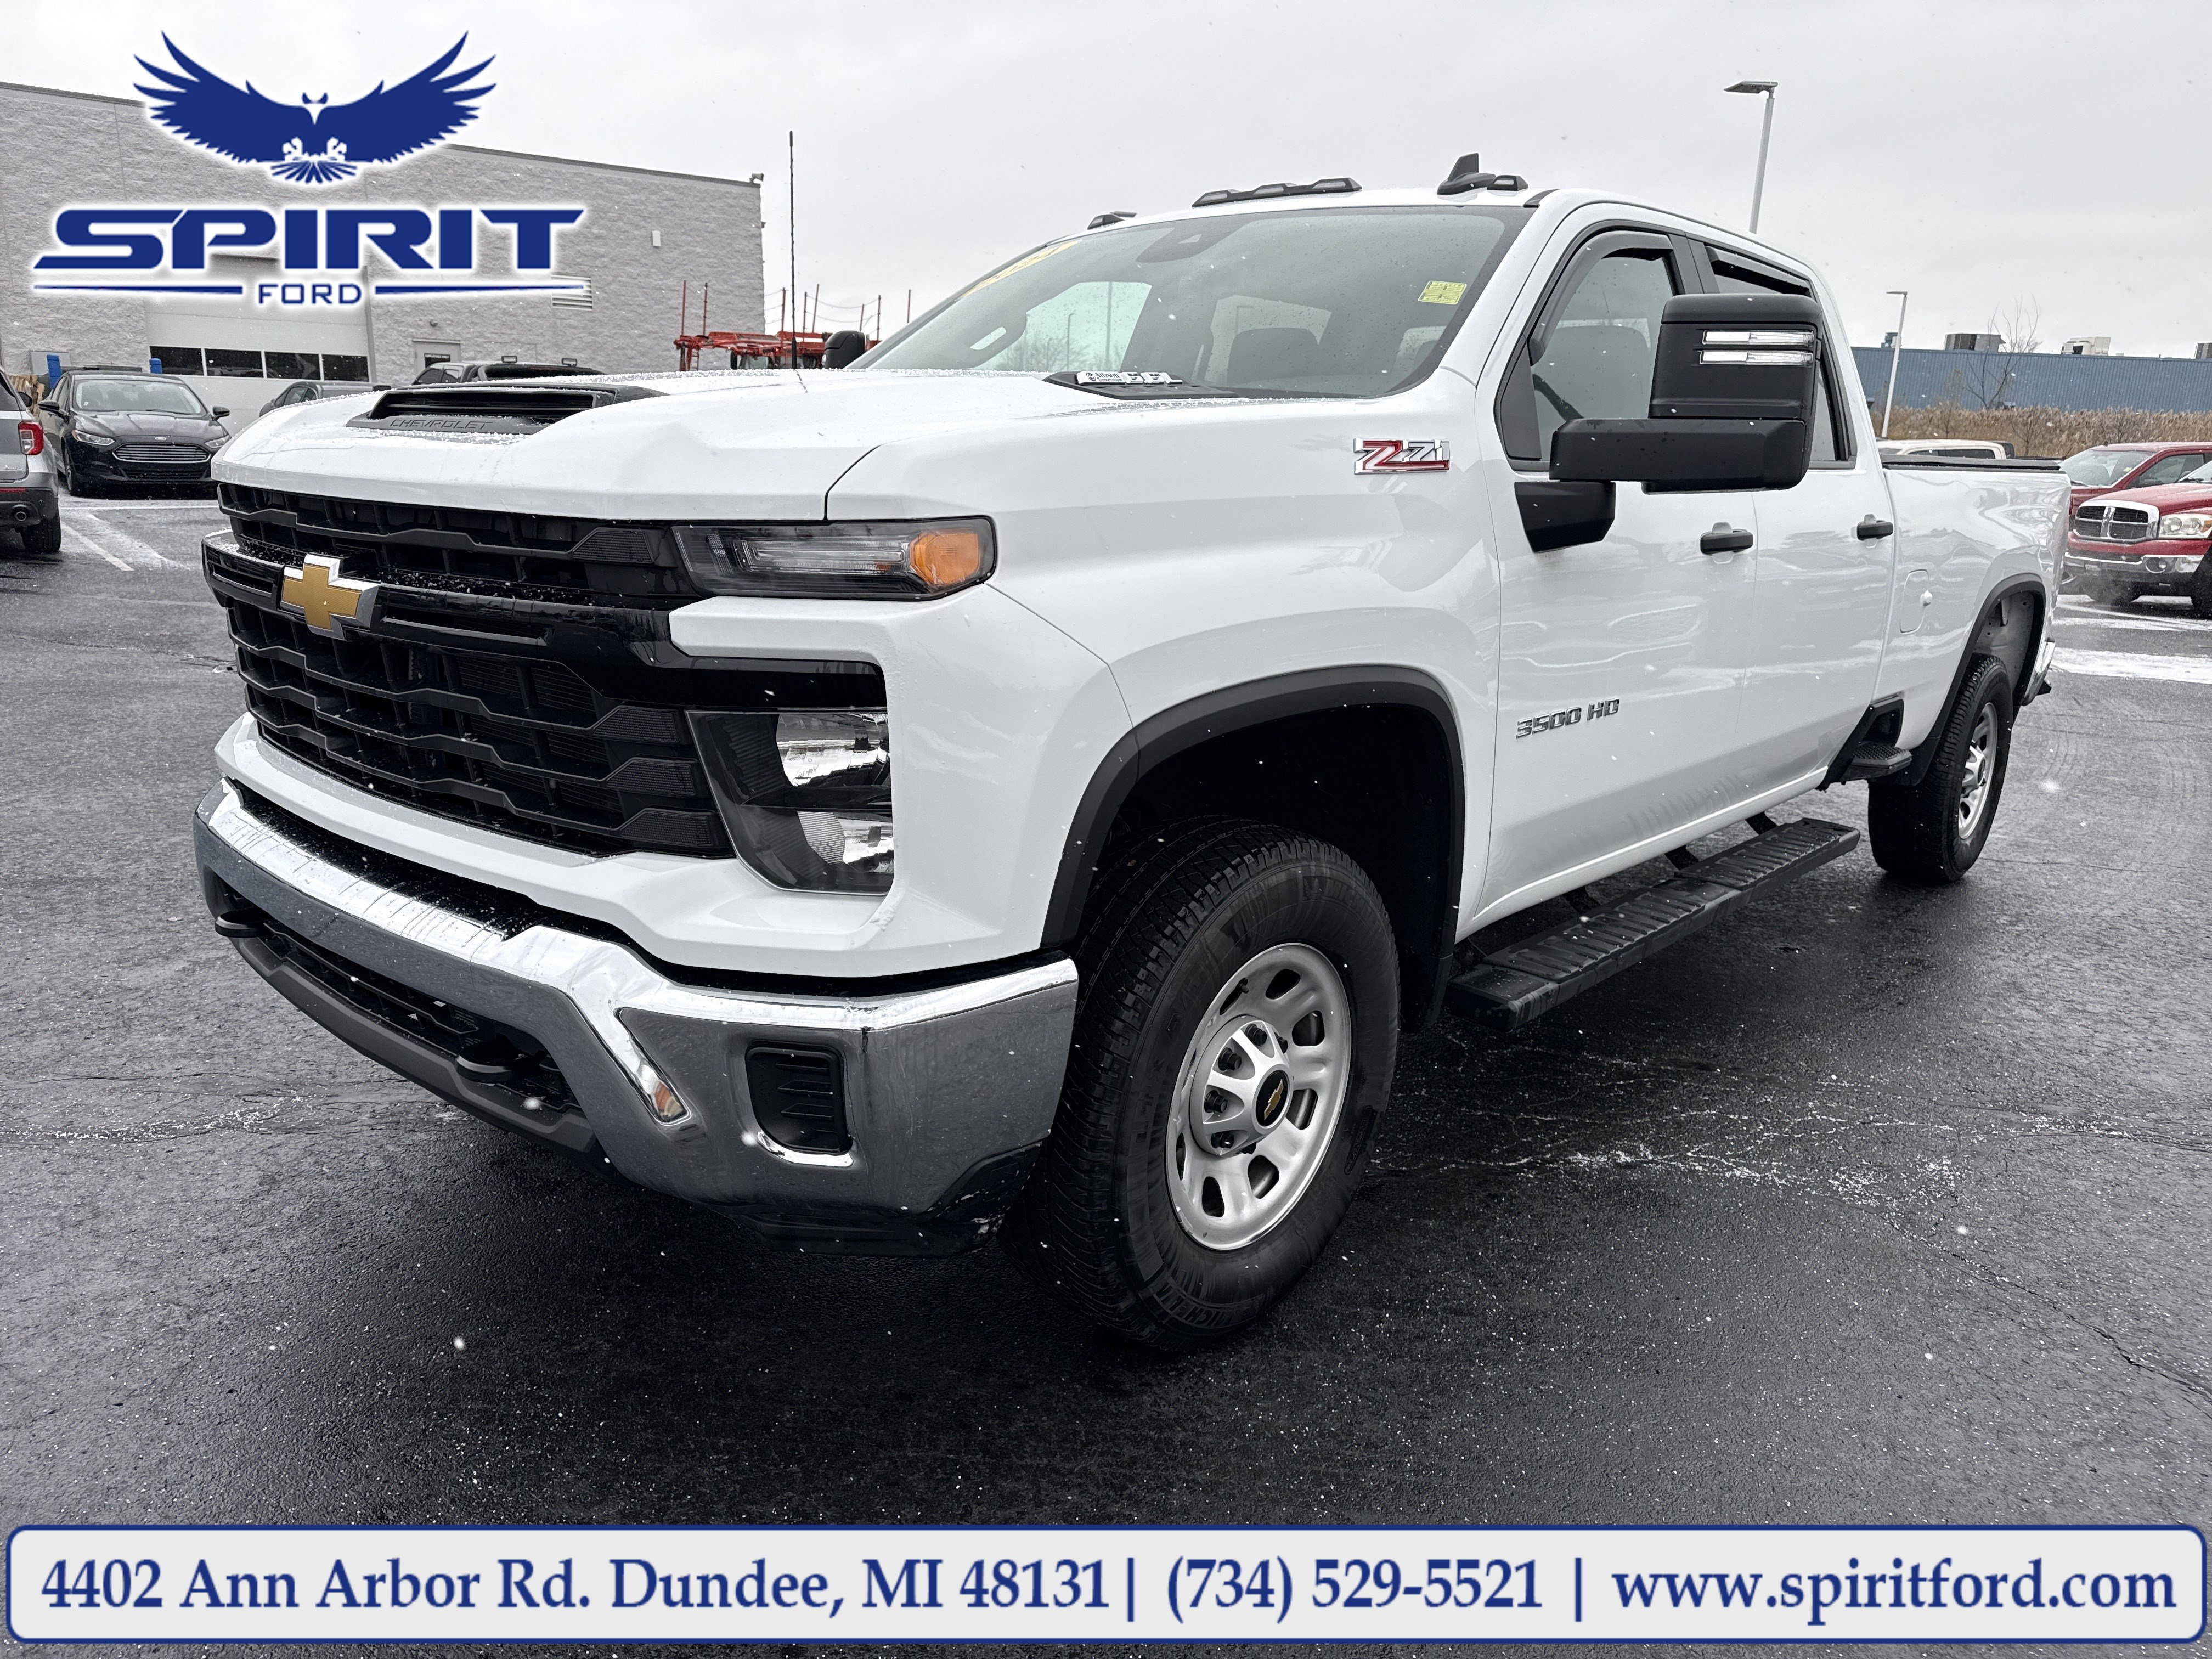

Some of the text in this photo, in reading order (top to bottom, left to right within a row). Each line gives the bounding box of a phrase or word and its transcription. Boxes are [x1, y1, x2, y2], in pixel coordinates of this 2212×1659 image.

[390, 419, 493, 430] CHEVROLET
[1353, 438, 1450, 475] Z71
[1516, 697, 1620, 739] 3500 HD
[1155, 1282, 1232, 1327] MICHELIN
